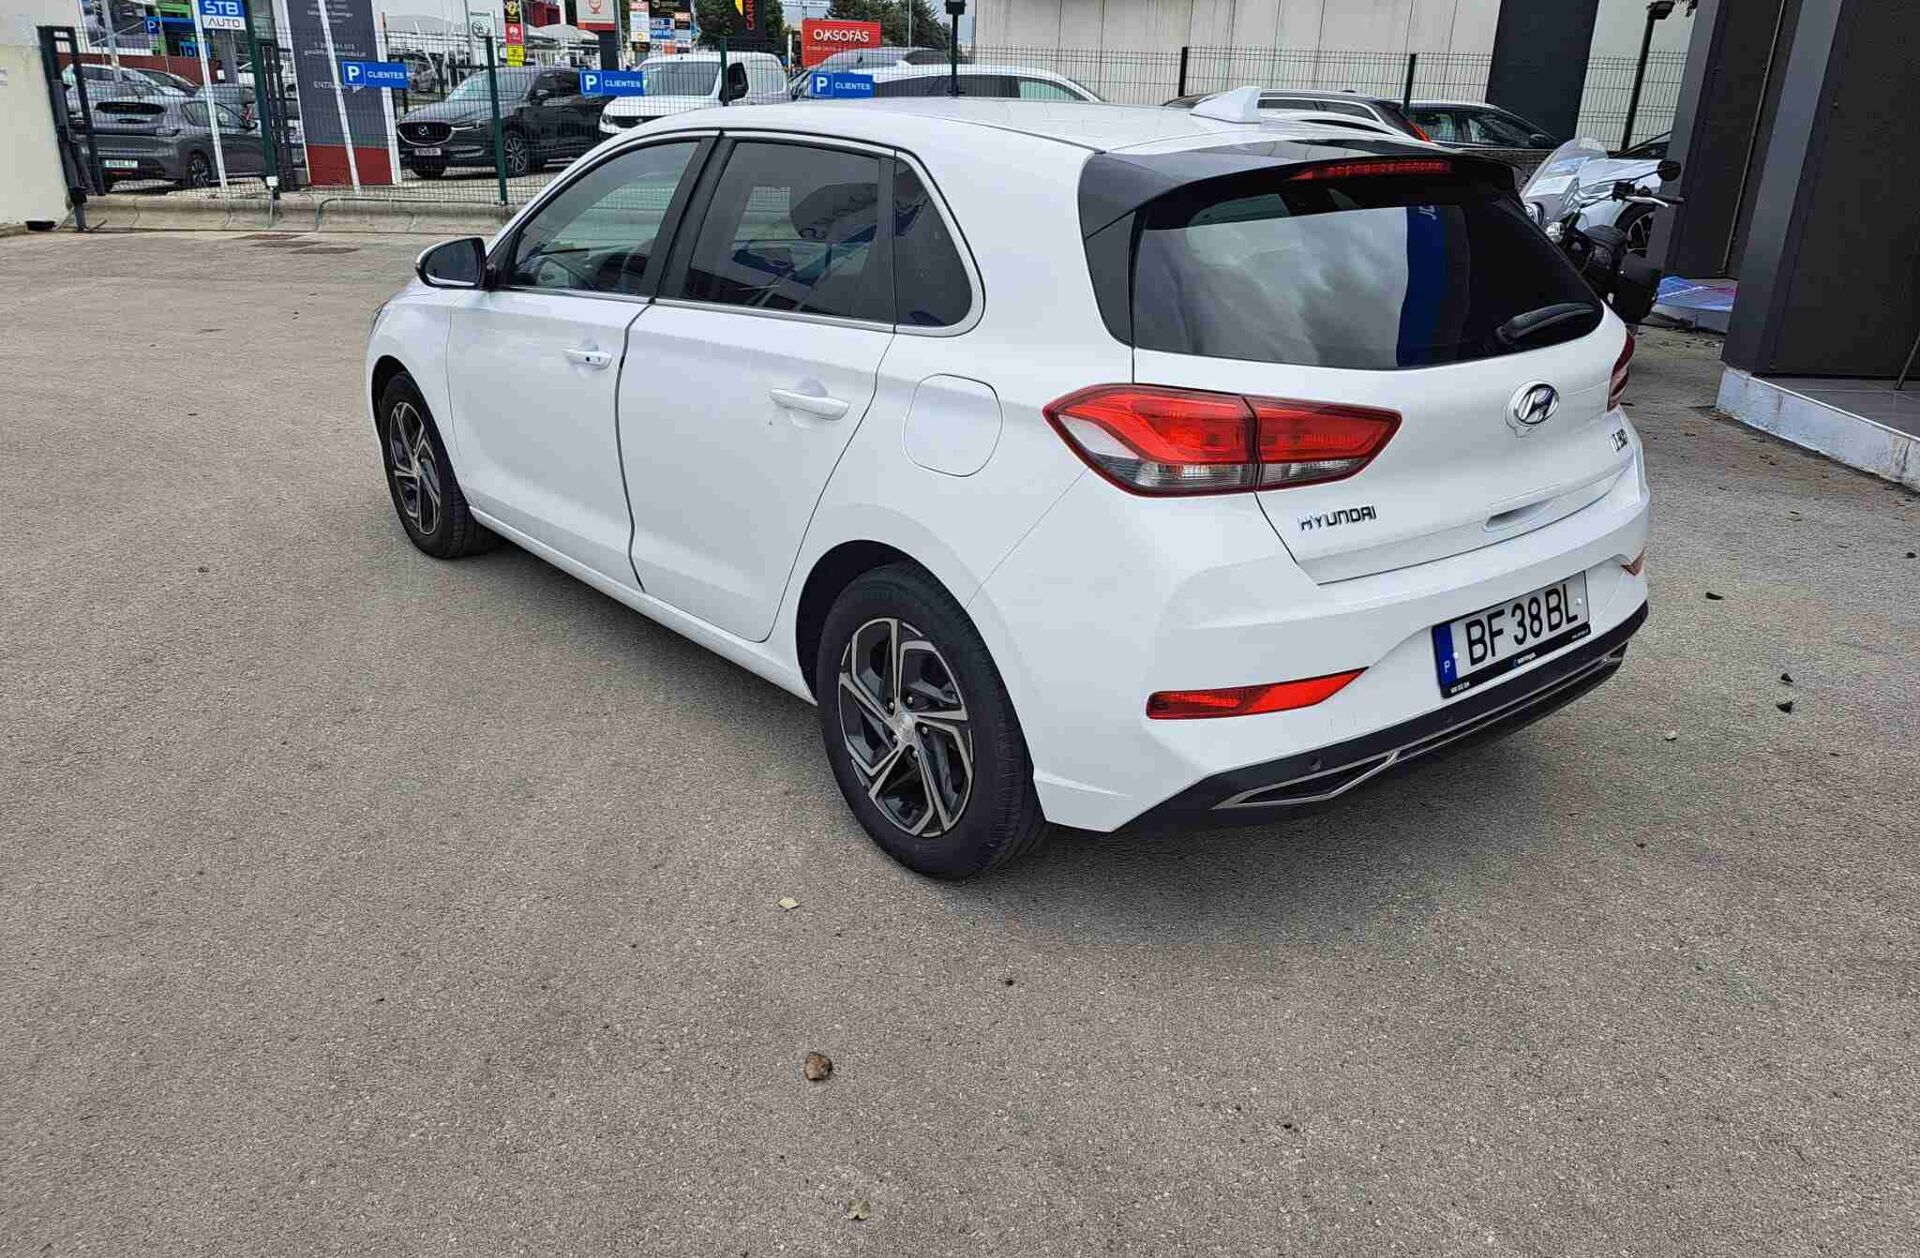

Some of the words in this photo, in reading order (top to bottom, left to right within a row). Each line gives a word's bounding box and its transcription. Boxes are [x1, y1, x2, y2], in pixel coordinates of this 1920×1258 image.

[204, 1, 239, 15] STB
[208, 18, 241, 28] AUTO
[347, 65, 360, 81] P
[367, 70, 405, 80] CLIENTES
[585, 74, 598, 91] P
[604, 79, 641, 88] CLIENTES
[816, 76, 828, 92] P
[834, 81, 871, 91] CLIENTES
[1299, 505, 1378, 532] HYUNDAI
[1465, 609, 1505, 667] BF
[1511, 596, 1543, 646] 38
[1545, 583, 1579, 633] BL
[1443, 660, 1451, 675] P
